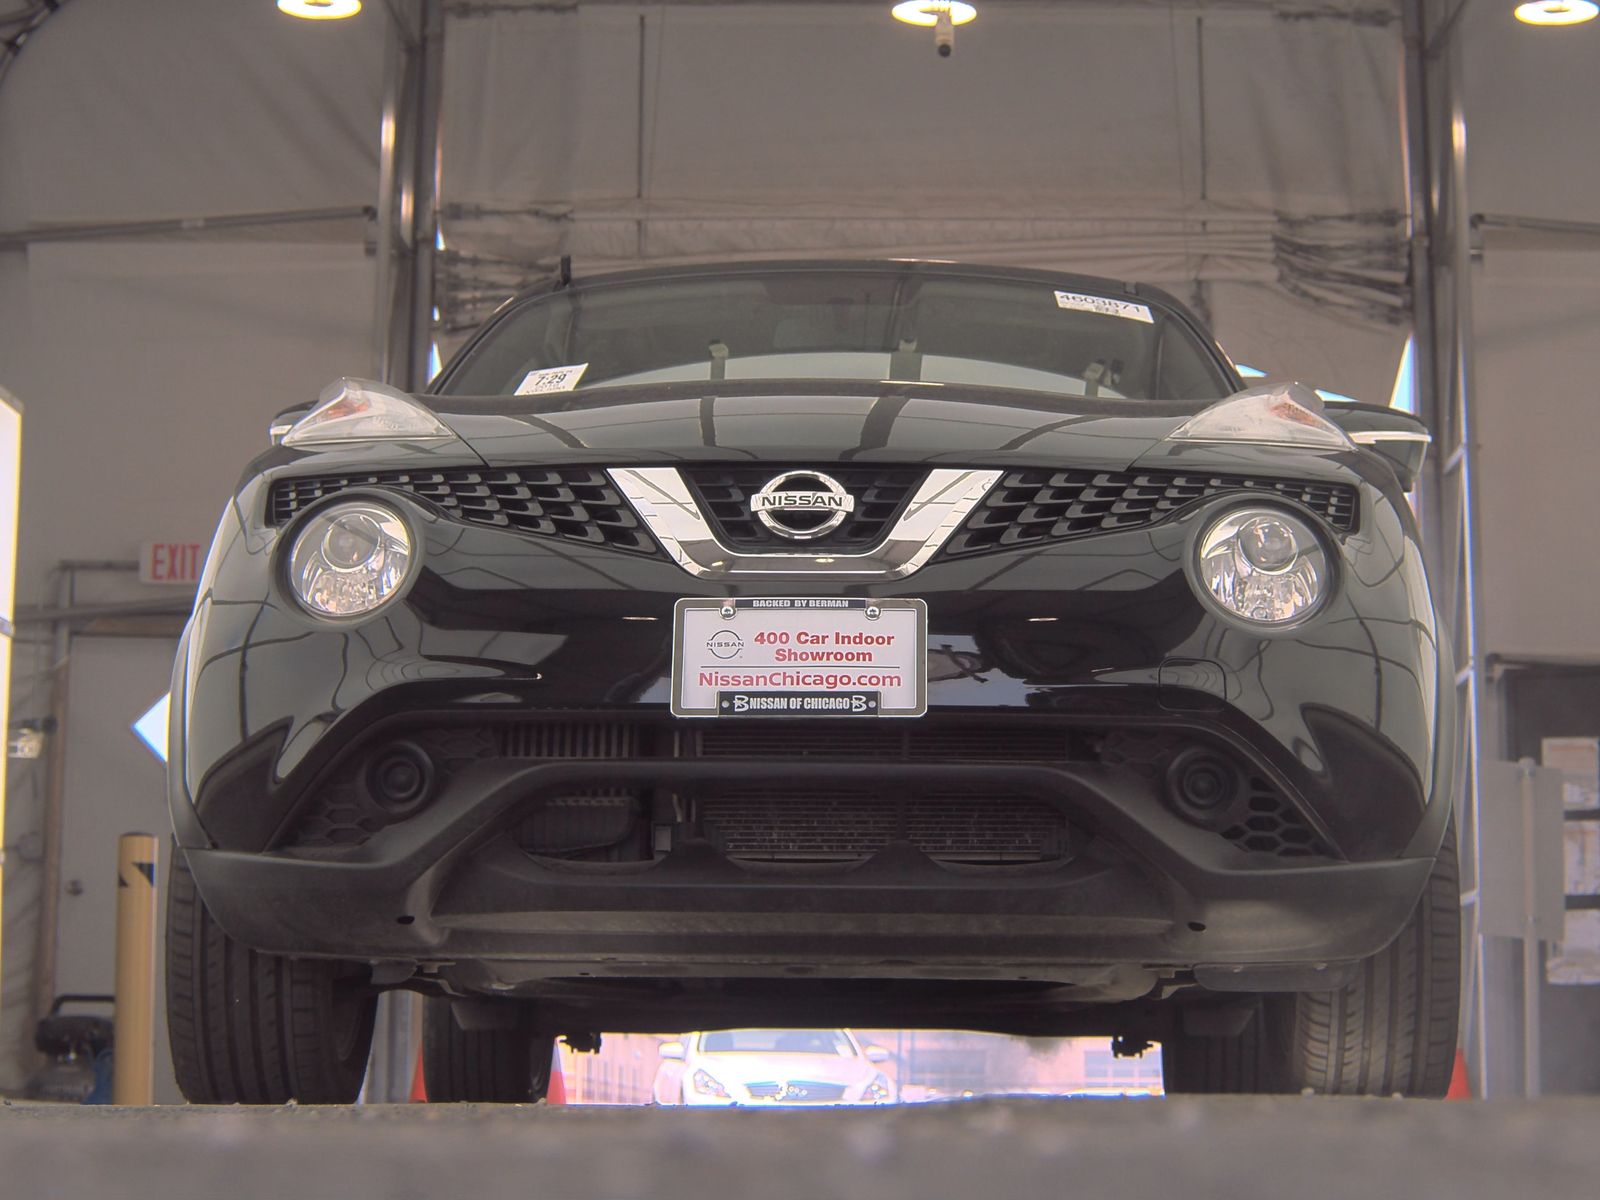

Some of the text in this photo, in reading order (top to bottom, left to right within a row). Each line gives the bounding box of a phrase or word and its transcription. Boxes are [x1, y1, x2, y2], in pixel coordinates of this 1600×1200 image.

[761, 495, 843, 507] NISSAN
[151, 544, 200, 579] EXIT
[752, 599, 849, 608] BACKED BY BERMAN
[754, 631, 895, 645] 400 Car Indoor
[774, 648, 873, 662] Showroom
[699, 671, 902, 690] NissanChicago.com
[749, 697, 788, 710] NISSAN
[789, 697, 803, 710] OF
[803, 697, 850, 710] CHICAGO
